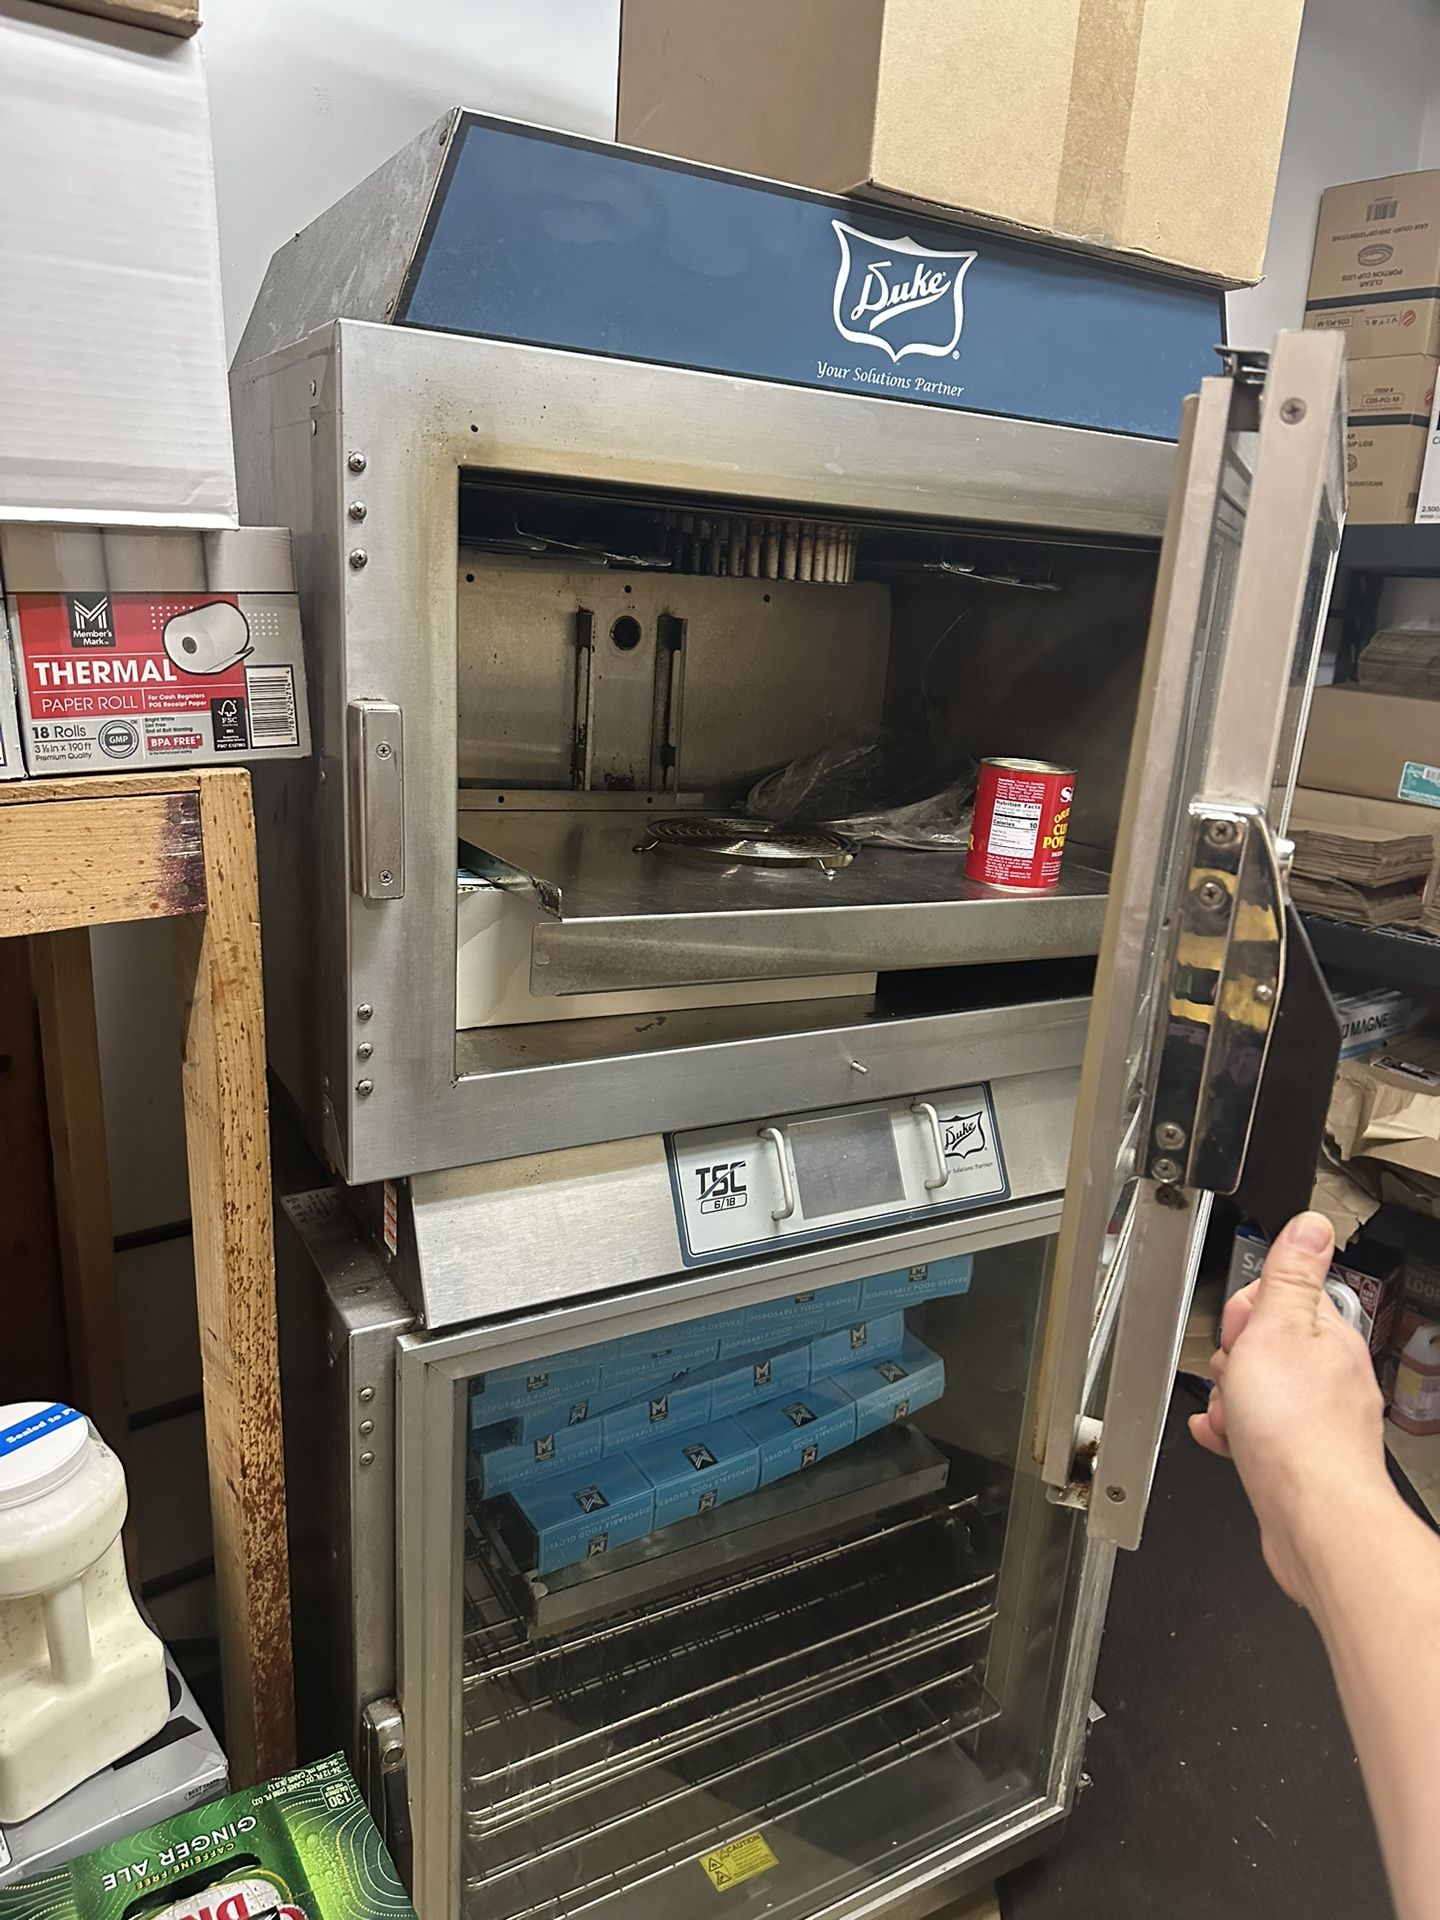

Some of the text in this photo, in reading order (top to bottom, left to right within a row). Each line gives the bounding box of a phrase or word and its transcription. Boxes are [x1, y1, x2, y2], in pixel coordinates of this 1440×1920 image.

[1360, 279, 1383, 288] CLEAR
[851, 261, 951, 331] Duke
[816, 360, 965, 398] Your Solutions Partner
[73, 630, 113, 638] Member's
[33, 659, 178, 686] THERMAL
[42, 695, 138, 713] PAPER ROLL
[221, 716, 238, 724] FSC
[32, 725, 86, 739] 18 Rolls
[109, 734, 128, 744] GMP
[69, 743, 83, 751] 190
[84, 742, 92, 750] ft
[151, 738, 171, 747] BPA
[35, 752, 92, 762] Premium Quality
[996, 800, 1021, 808] Nutrition
[944, 1120, 977, 1150] Duke
[714, 1197, 736, 1210] 6/18
[913, 1282, 936, 1291] FOOD
[5, 1420, 48, 1444] Sealed
[48, 1414, 62, 1423] to
[328, 1791, 352, 1808] 130
[726, 1834, 760, 1852] CAUTION
[101, 1815, 257, 1892] GINGER ALE
[135, 1842, 235, 1890] CAFFEINE FREE
